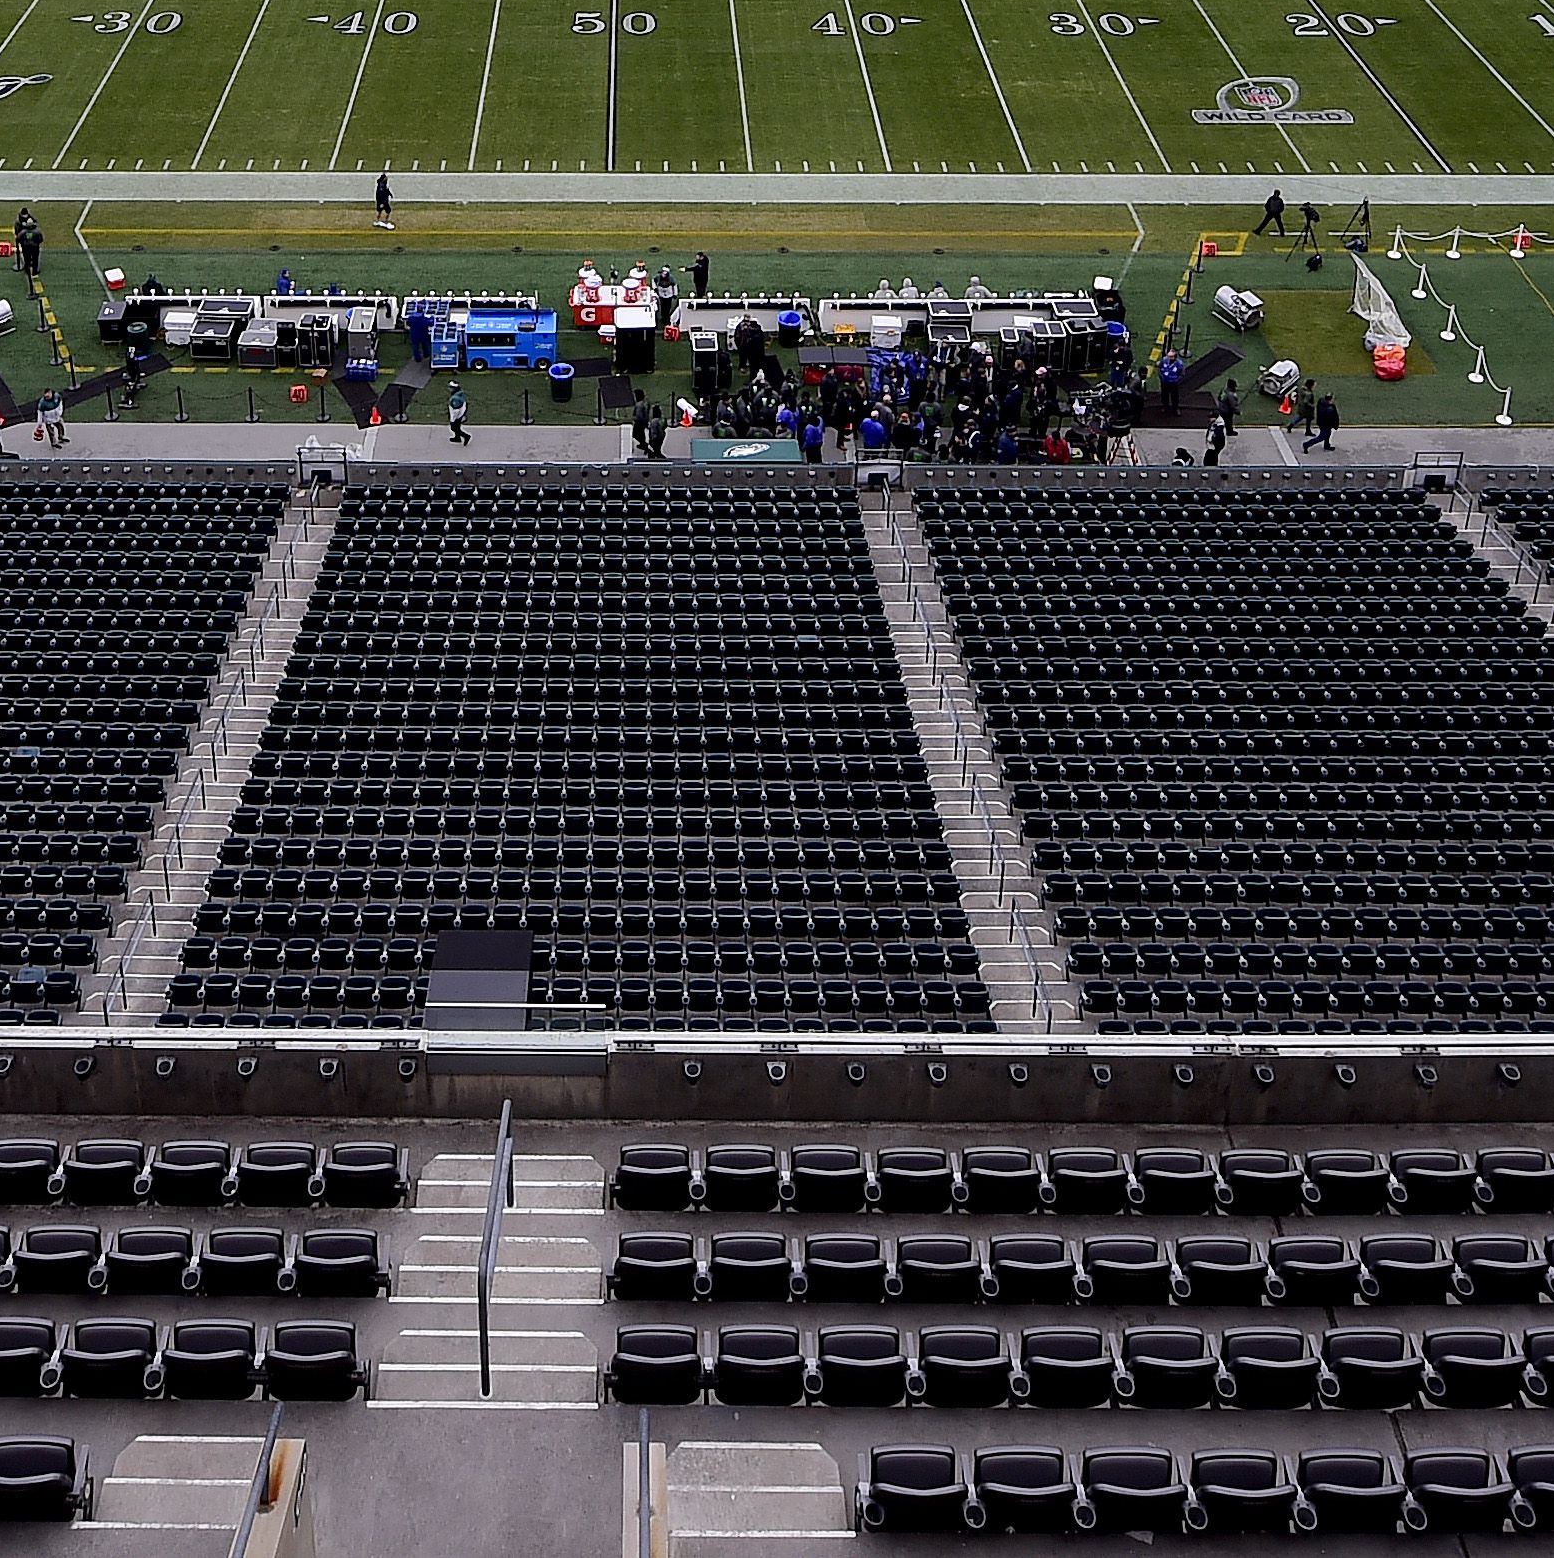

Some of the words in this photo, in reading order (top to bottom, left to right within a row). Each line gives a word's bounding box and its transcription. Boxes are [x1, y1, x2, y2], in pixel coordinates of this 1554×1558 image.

[92, 11, 184, 34] 30
[332, 11, 420, 35] 40
[571, 12, 658, 35] 50
[811, 12, 900, 35] 40
[1049, 13, 1136, 36] 30
[1285, 13, 1376, 37] 20
[1246, 94, 1276, 106] NFL
[1204, 111, 1258, 122] WILD
[1273, 111, 1343, 122] CARD
[580, 307, 596, 322] G
